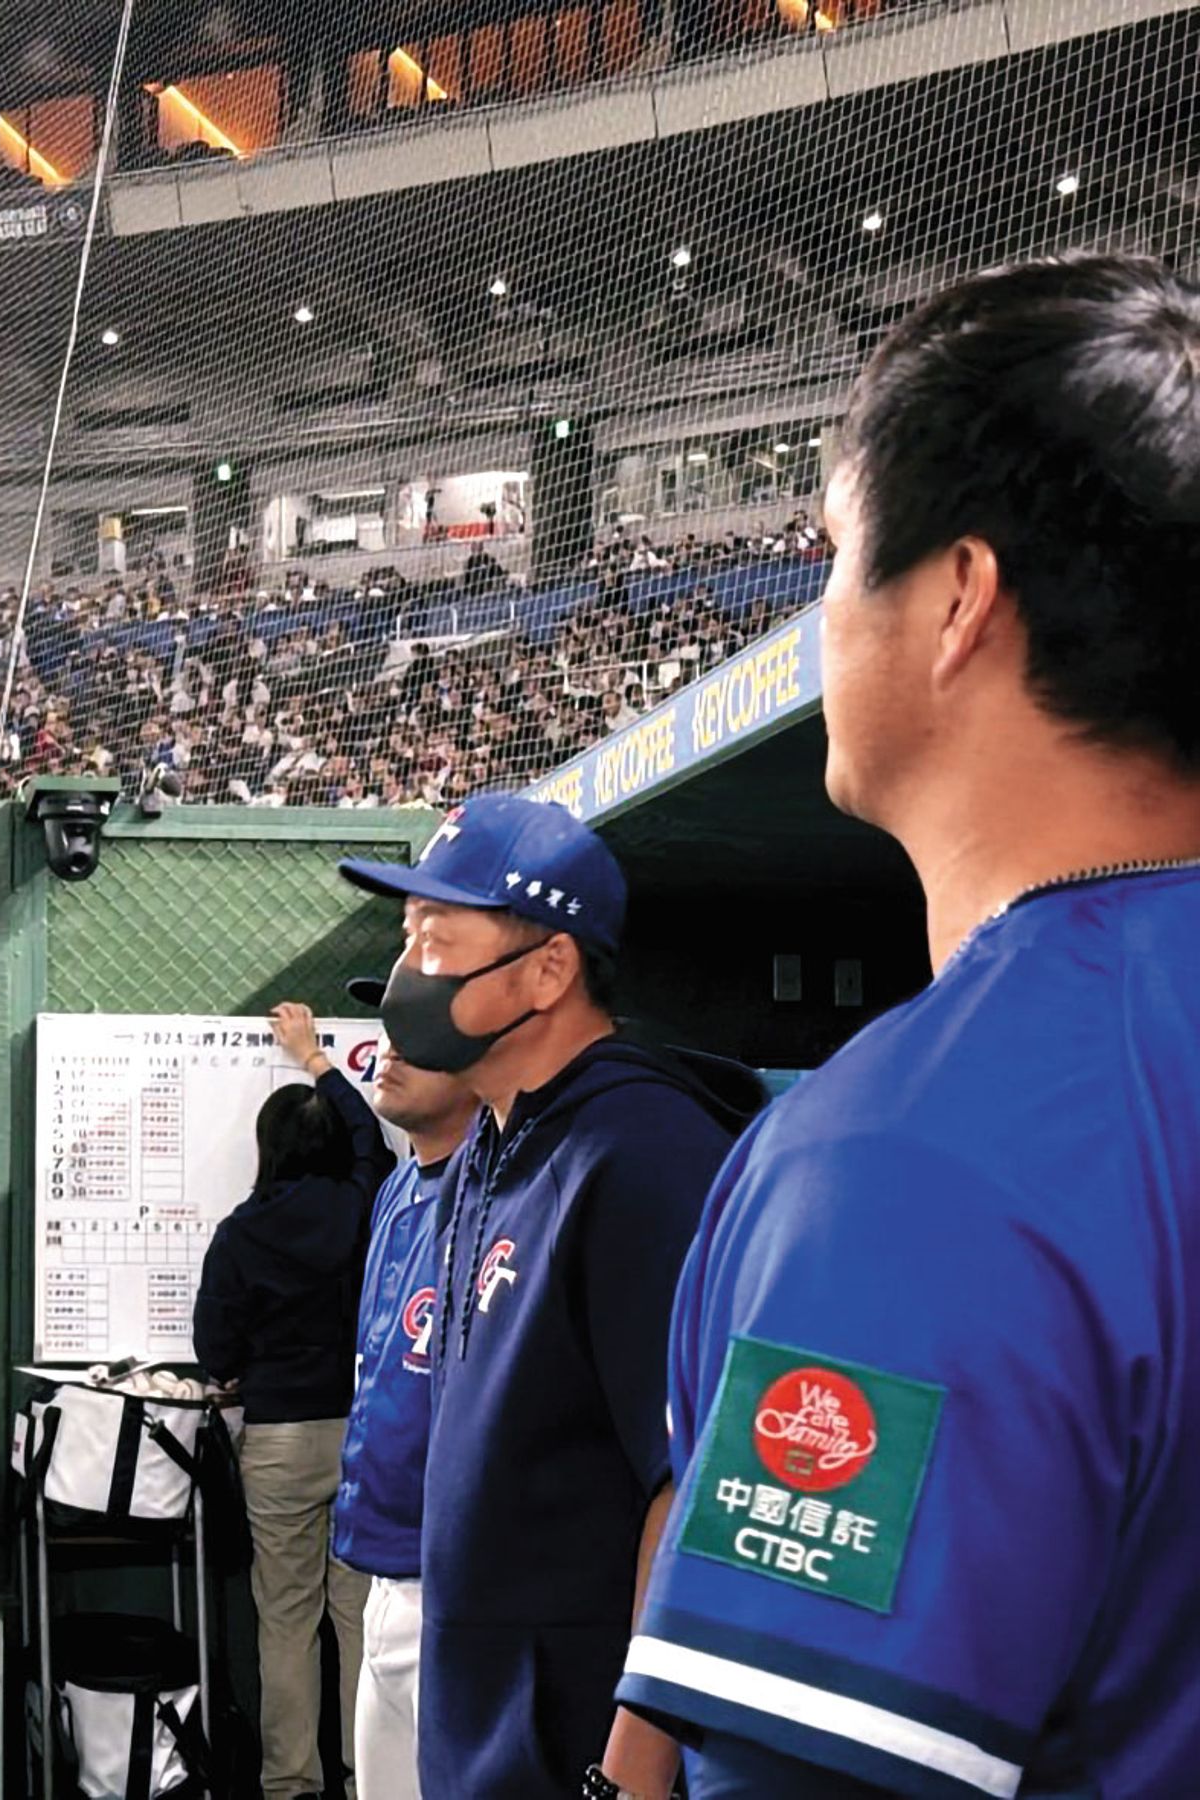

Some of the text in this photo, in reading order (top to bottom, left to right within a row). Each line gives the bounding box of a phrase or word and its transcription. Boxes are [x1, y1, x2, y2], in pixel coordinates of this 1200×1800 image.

[716, 1477, 878, 1553] 中國信託
[734, 1527, 834, 1582] CTBC
